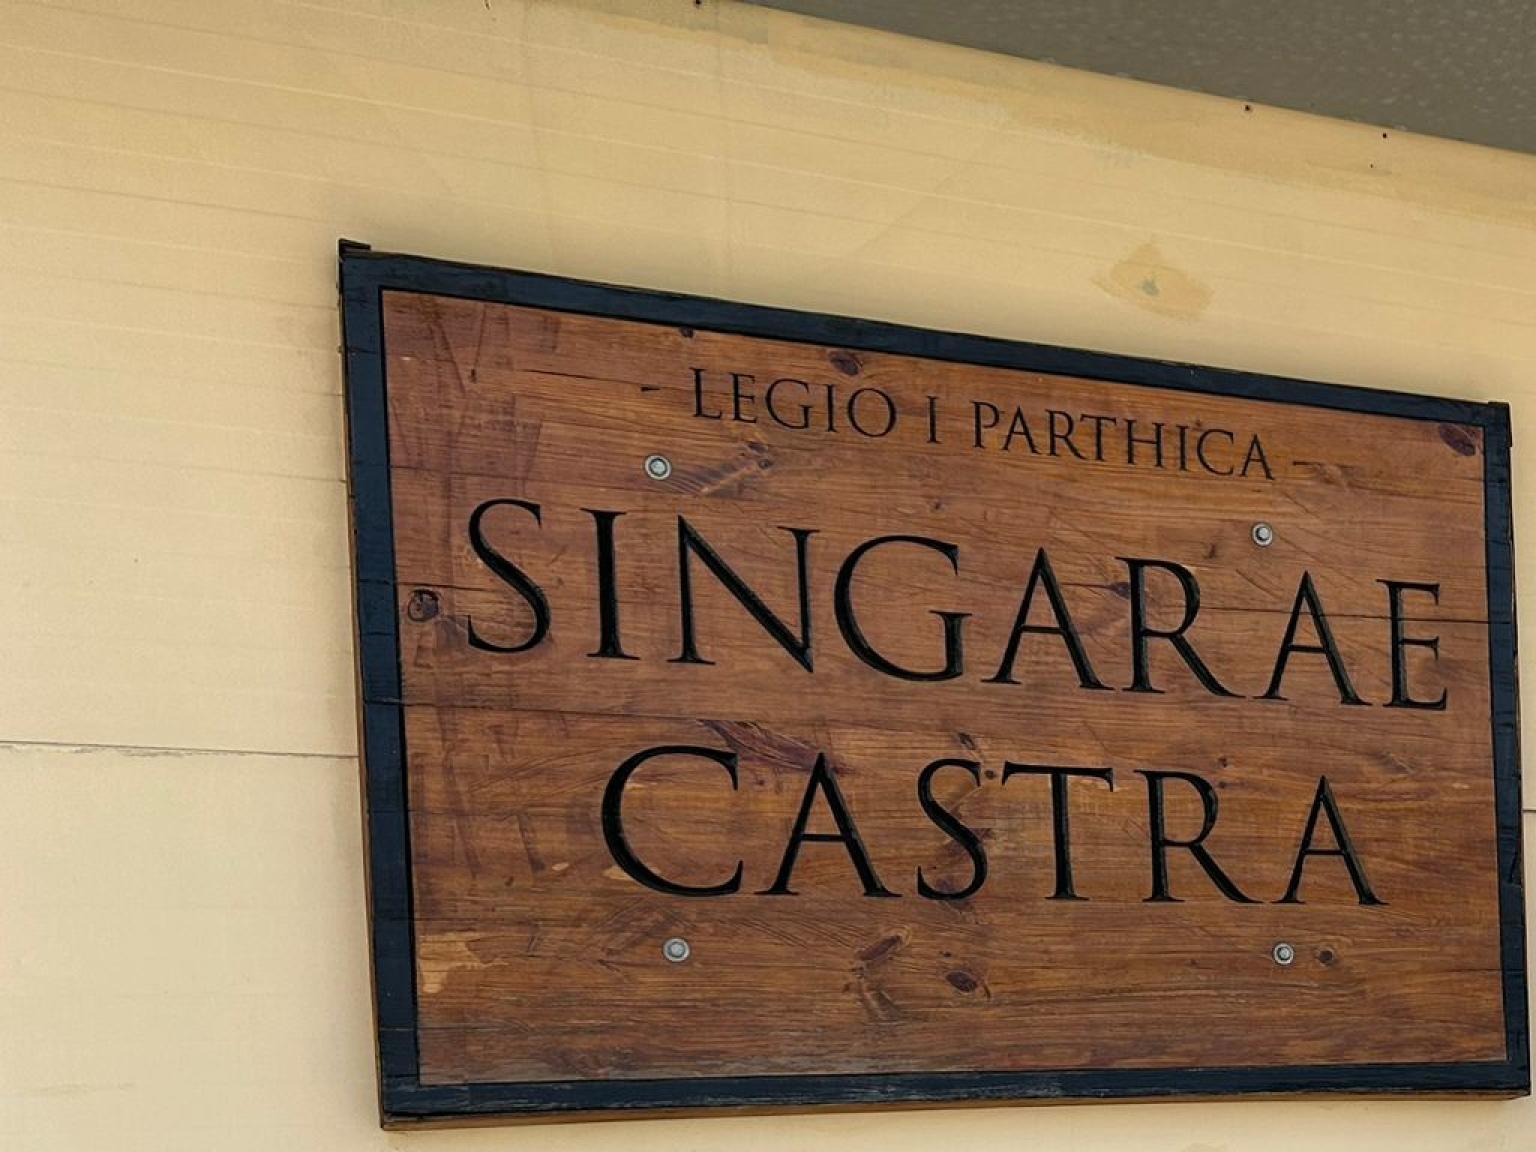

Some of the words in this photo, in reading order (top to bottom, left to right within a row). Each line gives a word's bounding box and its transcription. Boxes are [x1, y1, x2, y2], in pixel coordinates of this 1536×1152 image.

[690, 367, 898, 438] LEGIO
[926, 395, 940, 444] I
[969, 400, 1276, 480] PARTHICA
[466, 498, 1447, 711] SINGARAE
[601, 744, 1390, 906] CASTRA
